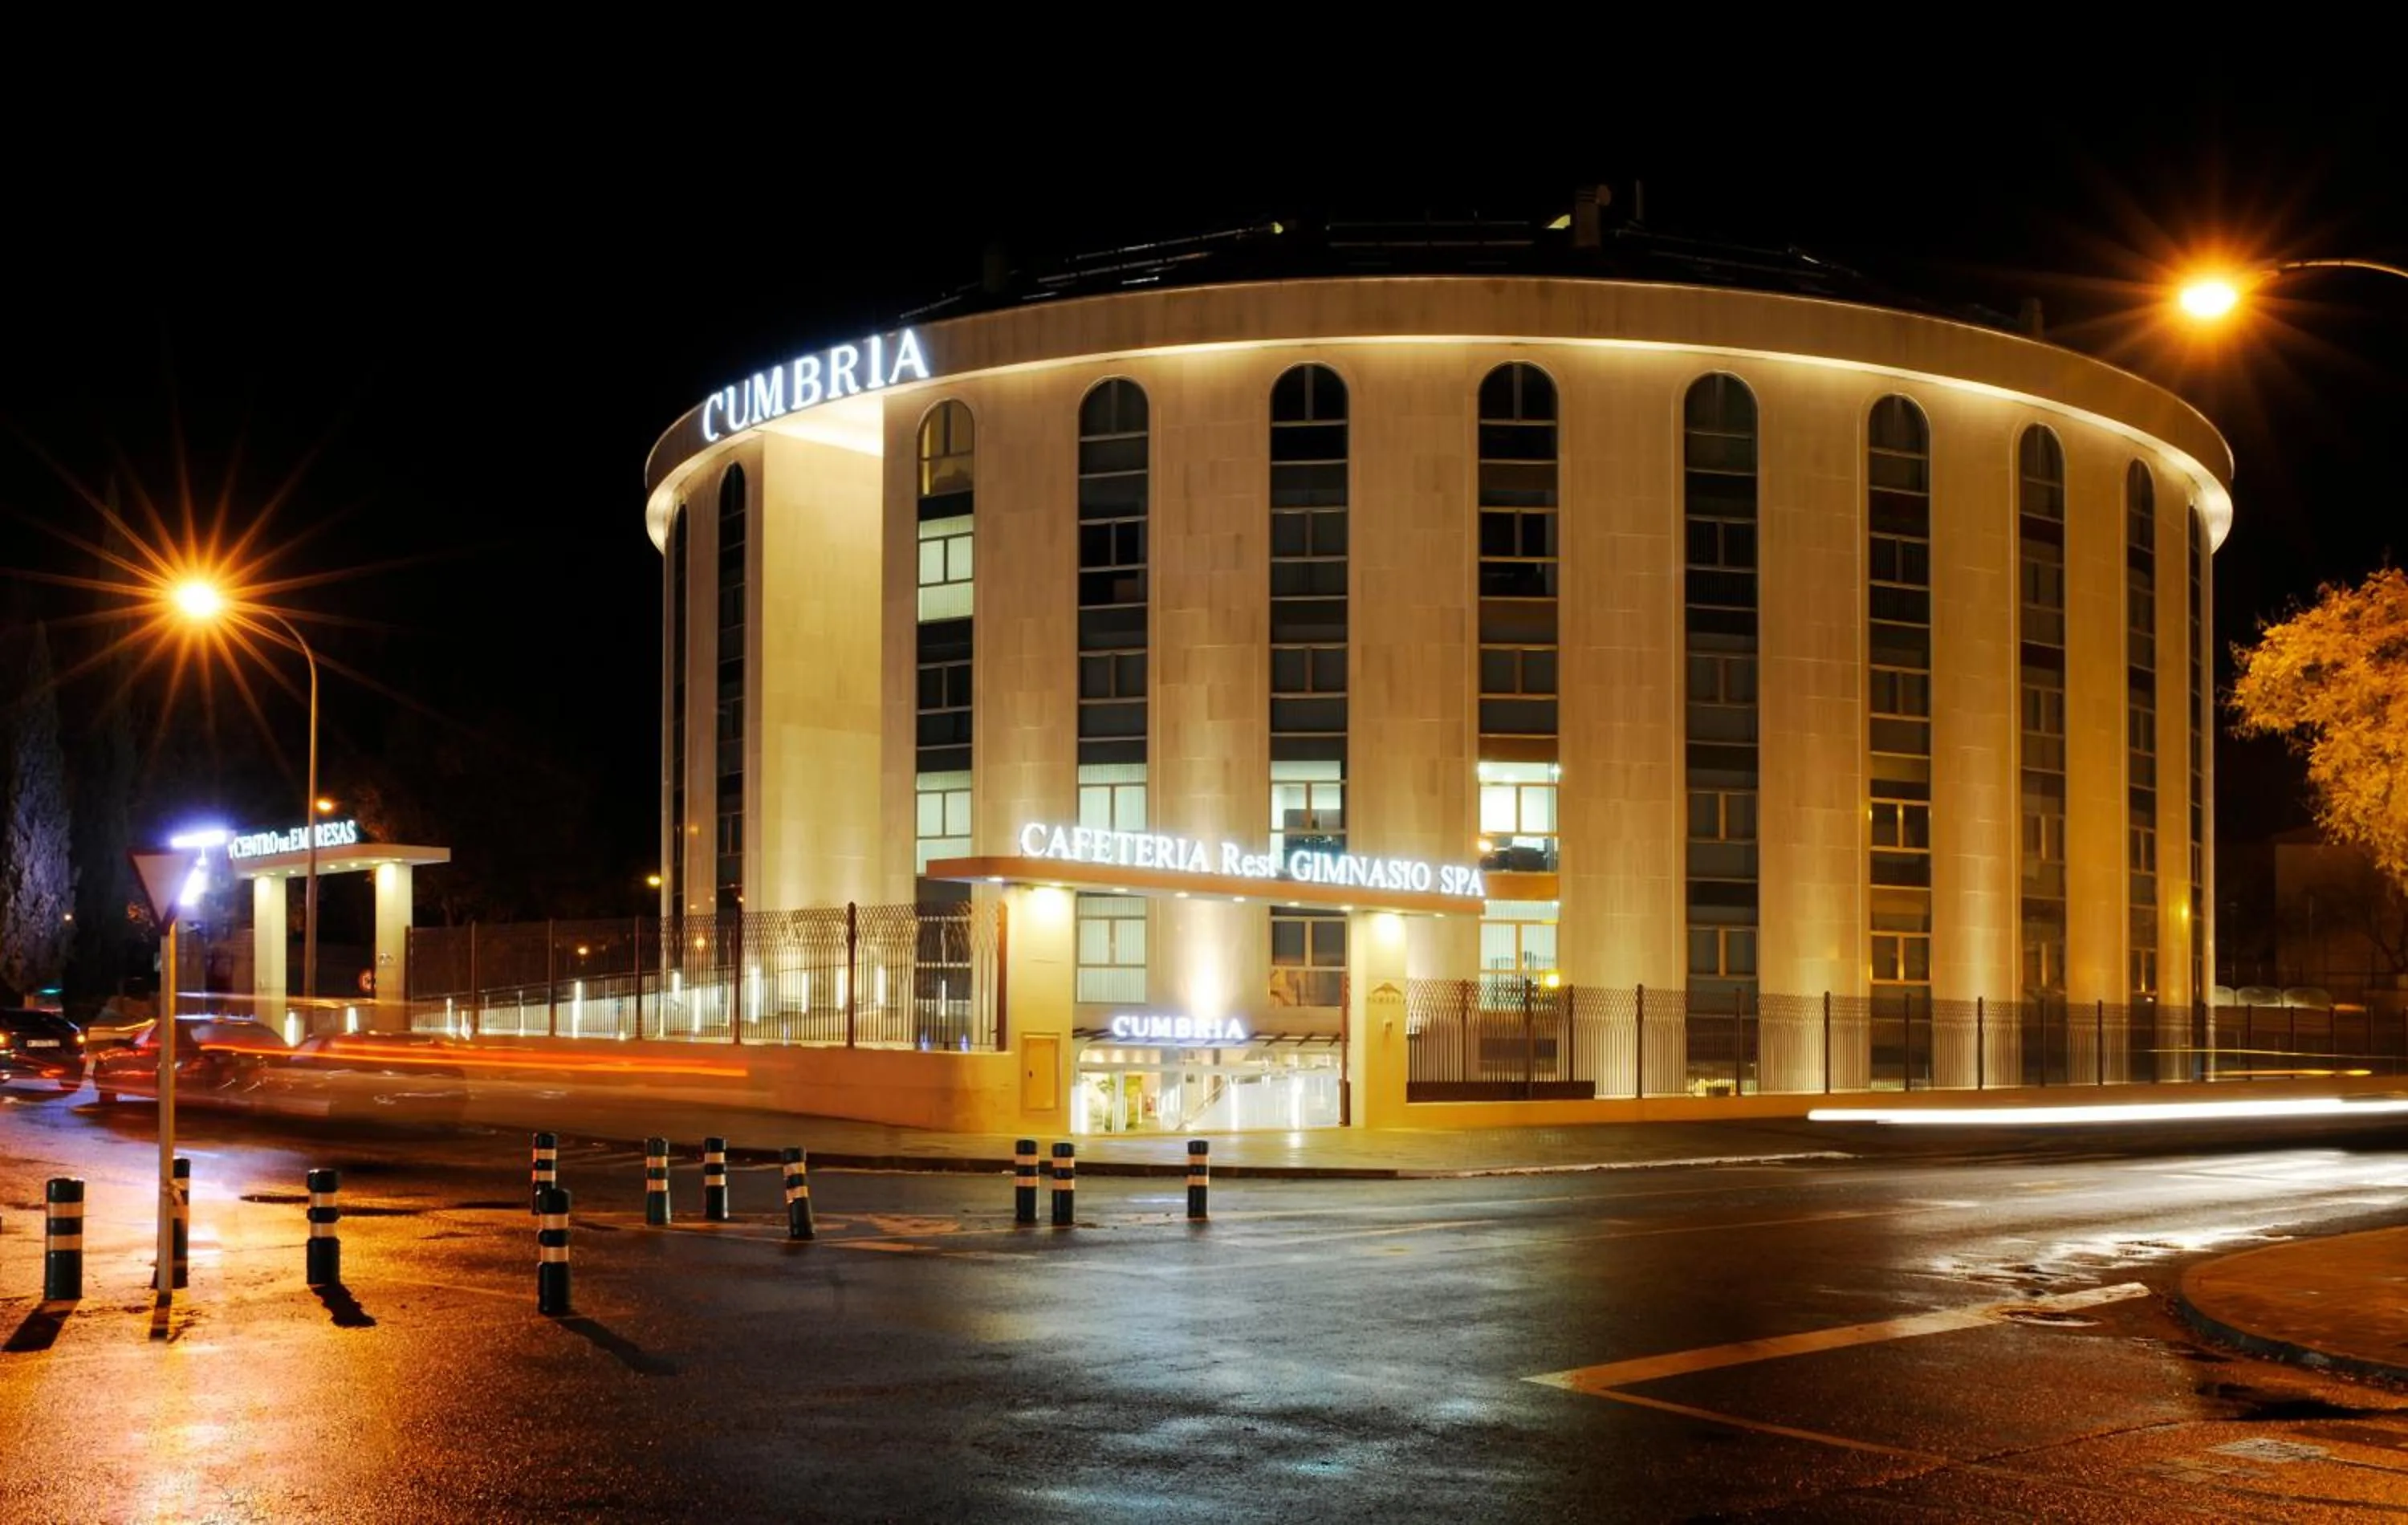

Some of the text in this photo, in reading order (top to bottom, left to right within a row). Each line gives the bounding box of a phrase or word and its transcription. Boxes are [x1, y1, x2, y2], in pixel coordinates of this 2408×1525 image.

[702, 327, 930, 442] CUMBRIA
[234, 831, 278, 858] CENTRO
[290, 819, 357, 851] EMRESAS
[1020, 822, 1211, 872] CAFETERIA
[1289, 849, 1431, 892] GIMNASIO
[1440, 864, 1485, 897] SPA
[1112, 1015, 1246, 1039] CUMBRIA
